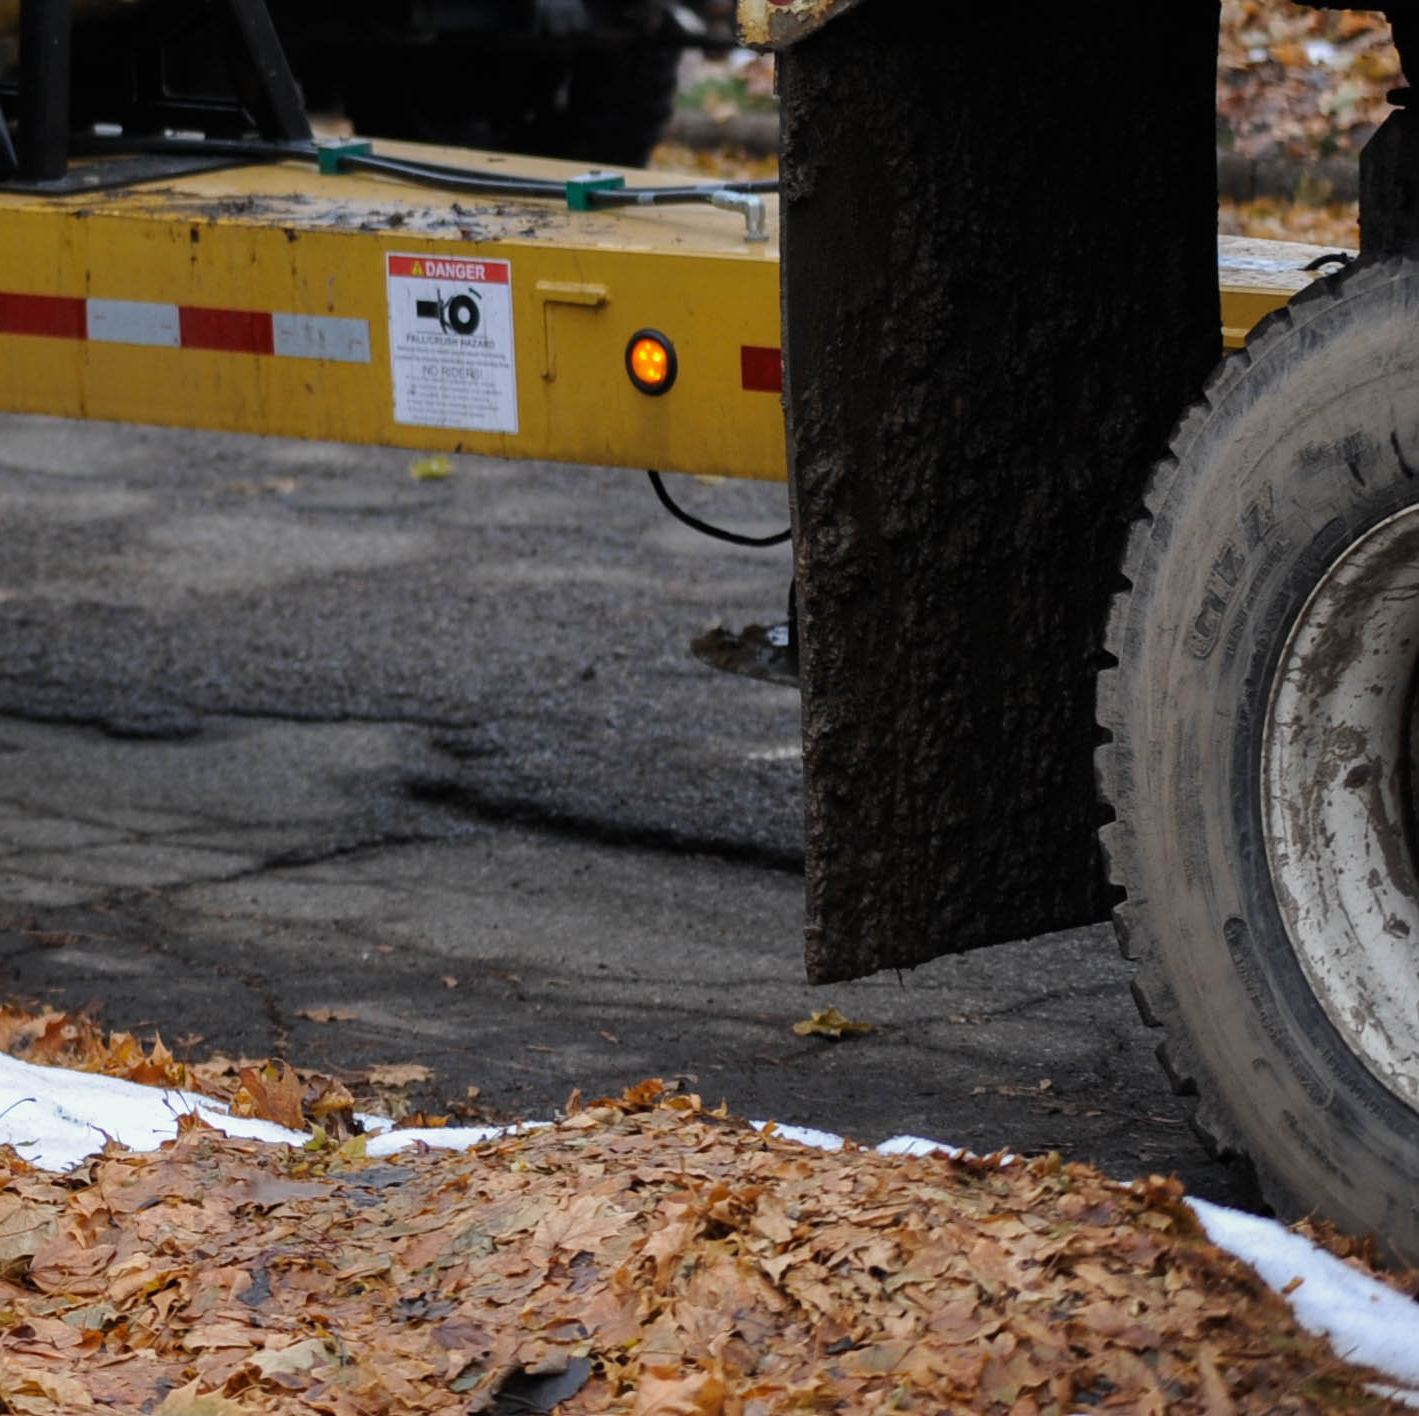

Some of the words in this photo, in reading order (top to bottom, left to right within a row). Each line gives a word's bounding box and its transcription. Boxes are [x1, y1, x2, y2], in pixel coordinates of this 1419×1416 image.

[425, 261, 486, 280] DANGER
[460, 337, 496, 350] HAZARD
[423, 365, 440, 377] NO
